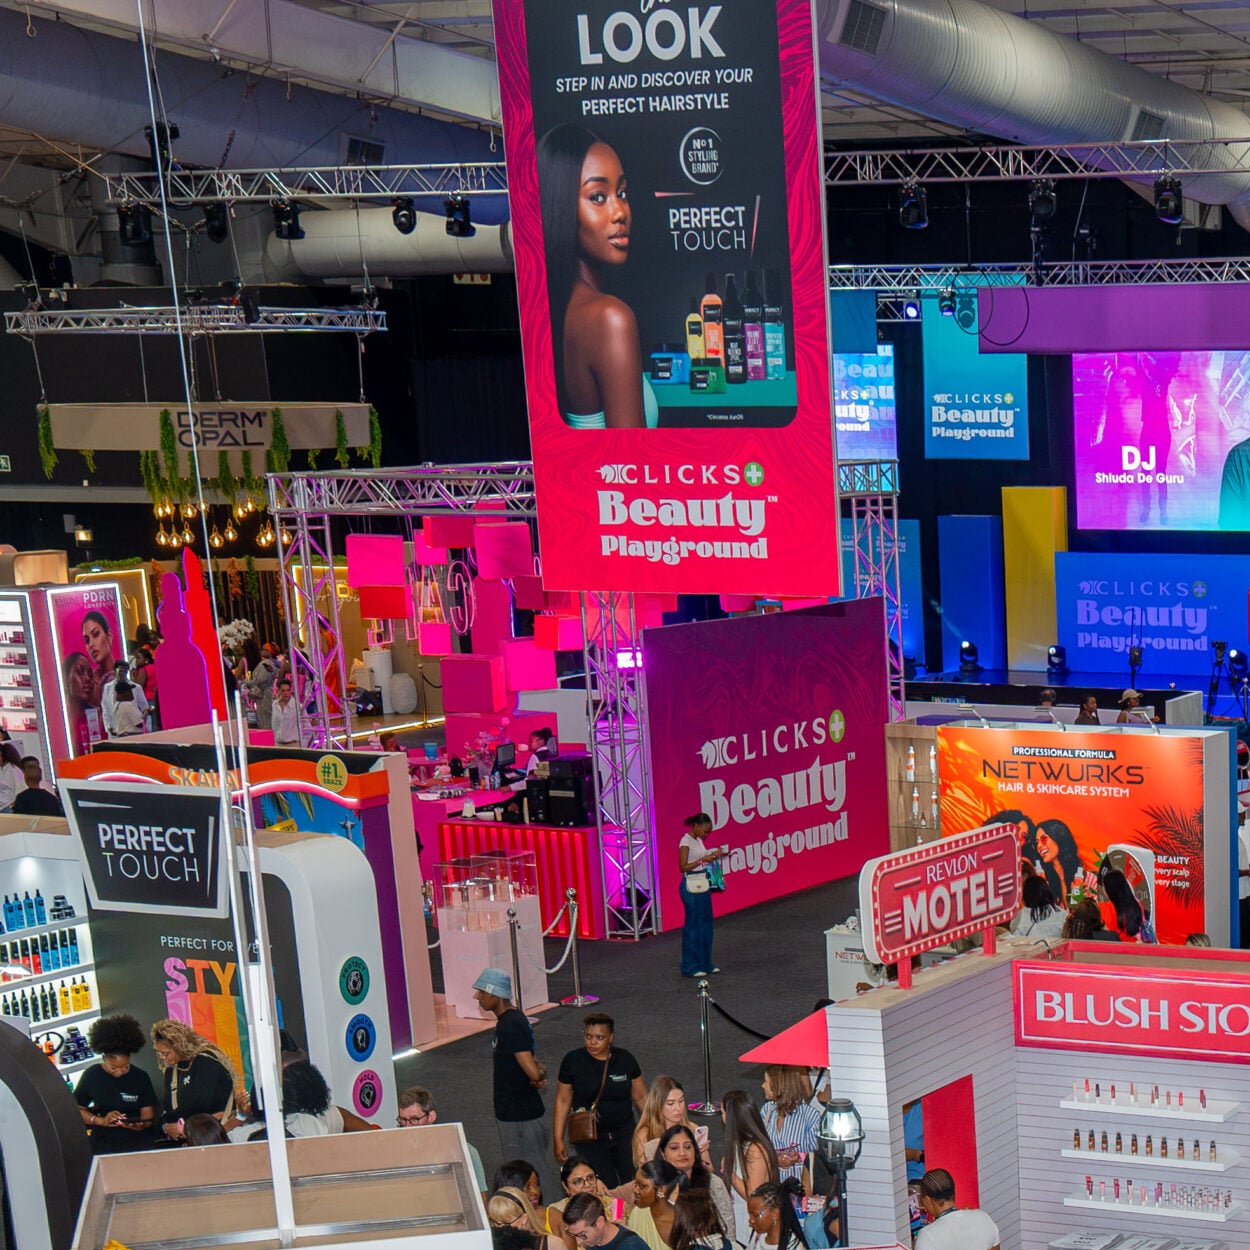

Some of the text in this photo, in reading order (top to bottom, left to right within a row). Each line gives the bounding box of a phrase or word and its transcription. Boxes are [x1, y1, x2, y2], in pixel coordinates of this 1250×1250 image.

[577, 6, 726, 65] LOOK
[556, 68, 753, 93] STEP IN AND DISCOVER YOUR
[582, 93, 729, 115] PERFECT HAIRSTYLE
[688, 150, 719, 162] STYLING
[669, 206, 746, 229] PERFECT
[670, 230, 746, 251] TOUCH
[944, 393, 1003, 404] CLICKS
[177, 411, 263, 428] DERM
[932, 406, 1014, 427] Beauty
[178, 429, 264, 448] OPAL
[932, 427, 1014, 440] Playground
[1121, 446, 1156, 470] DJ
[621, 464, 740, 485] CLICKS
[1137, 473, 1153, 484] De
[1156, 473, 1184, 484] Guru
[597, 490, 766, 536] Beauty
[600, 535, 768, 565] Playground
[1097, 582, 1188, 596] CLICKS
[1077, 599, 1208, 633] Beauty
[1078, 632, 1208, 654] Playground
[721, 717, 827, 765] CLICKS
[1013, 747, 1115, 759] PROFESSIONAL FORMULA
[982, 759, 1145, 785] NETWURKS
[699, 755, 847, 831] Beauty
[998, 782, 1130, 798] HAIR & SKINCARE SYSTEM
[98, 823, 196, 854] PERFECT
[101, 852, 199, 883] TOUCH
[926, 851, 978, 885] REVLON
[1157, 855, 1190, 865] BEAUTY
[1173, 868, 1190, 877] scalp
[1154, 879, 1190, 889] very stage
[903, 868, 1003, 941] MOTEL
[160, 935, 207, 950] PERFECT
[211, 940, 234, 951] FOR
[164, 957, 243, 998] STY
[342, 962, 367, 979] PROTECT
[1035, 990, 1170, 1031] BLUSH
[349, 1018, 372, 1034] SMOOTH
[359, 1075, 375, 1084] HOLD
